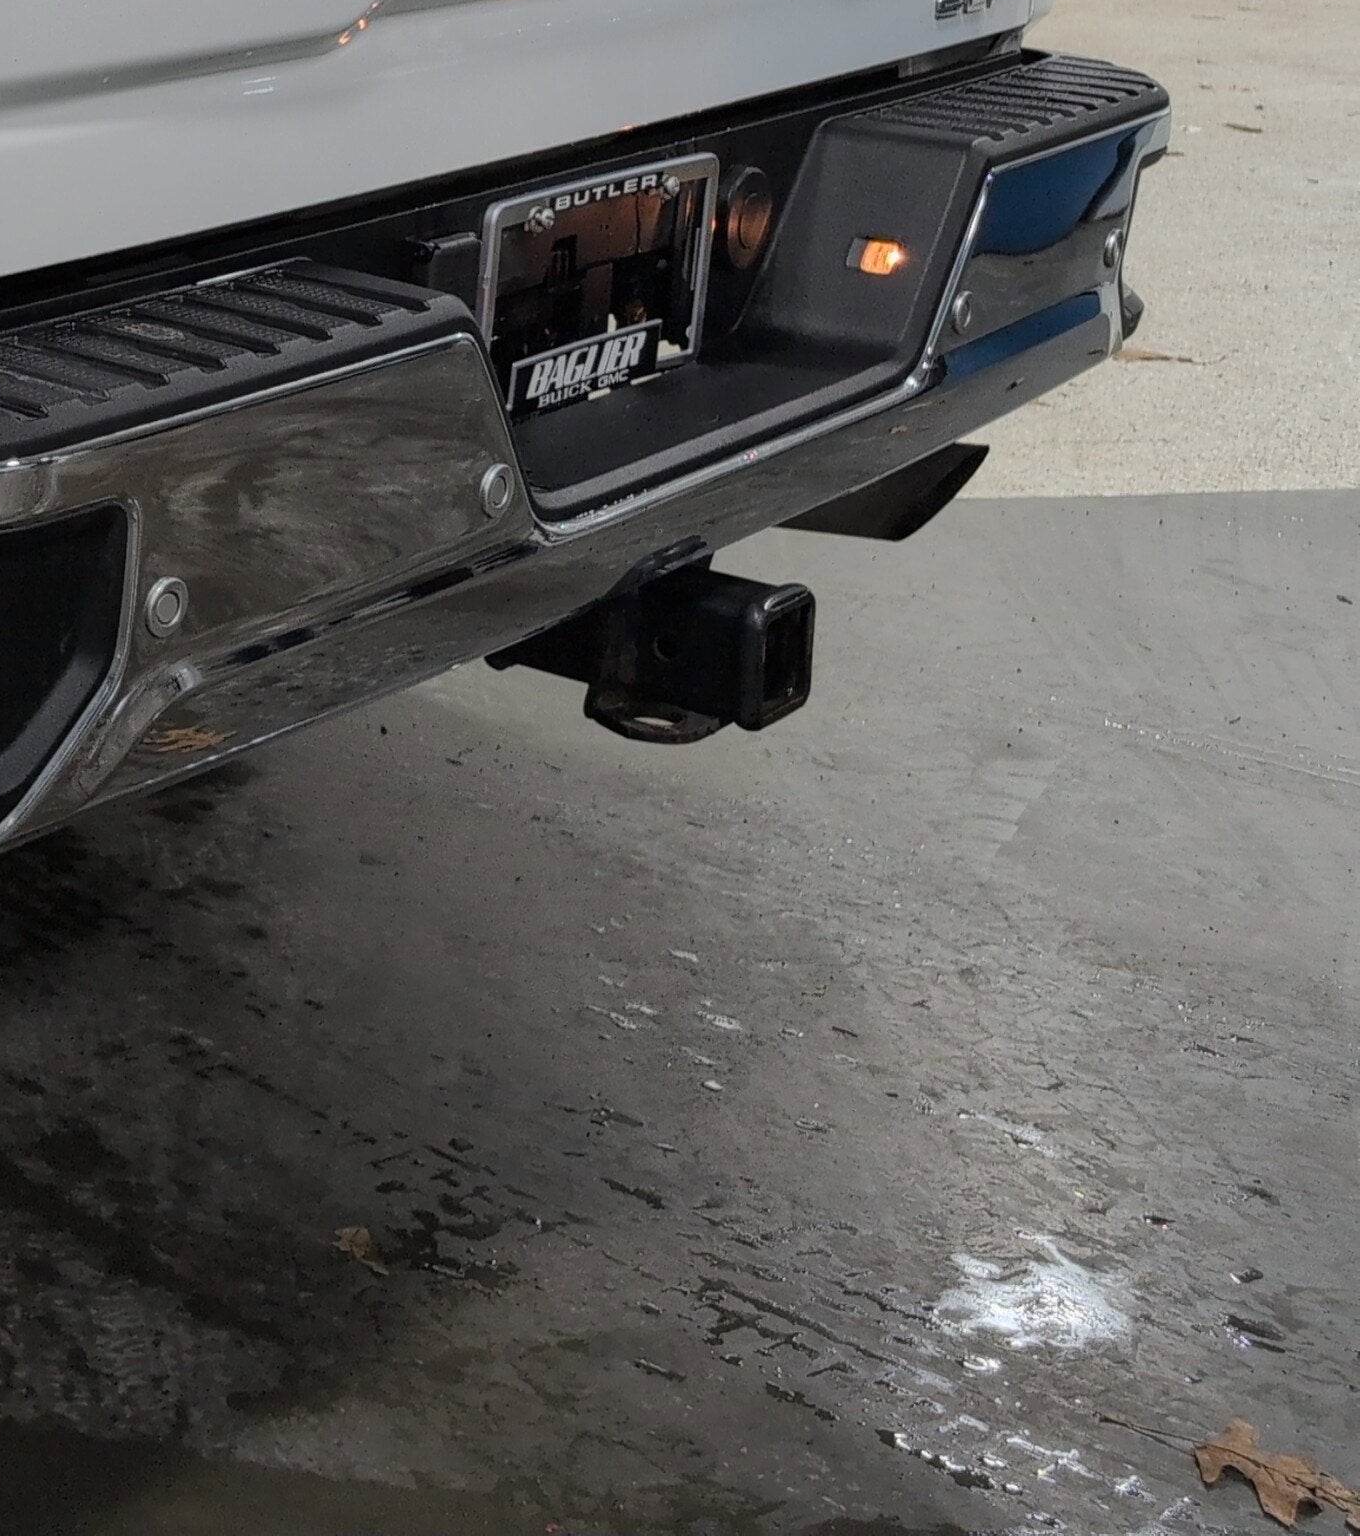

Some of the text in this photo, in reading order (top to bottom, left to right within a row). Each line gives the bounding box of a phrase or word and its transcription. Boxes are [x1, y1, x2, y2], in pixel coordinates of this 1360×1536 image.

[554, 174, 658, 211] BUTLER
[526, 330, 647, 400] BAGLIER
[538, 369, 630, 408] BUICK GMC
